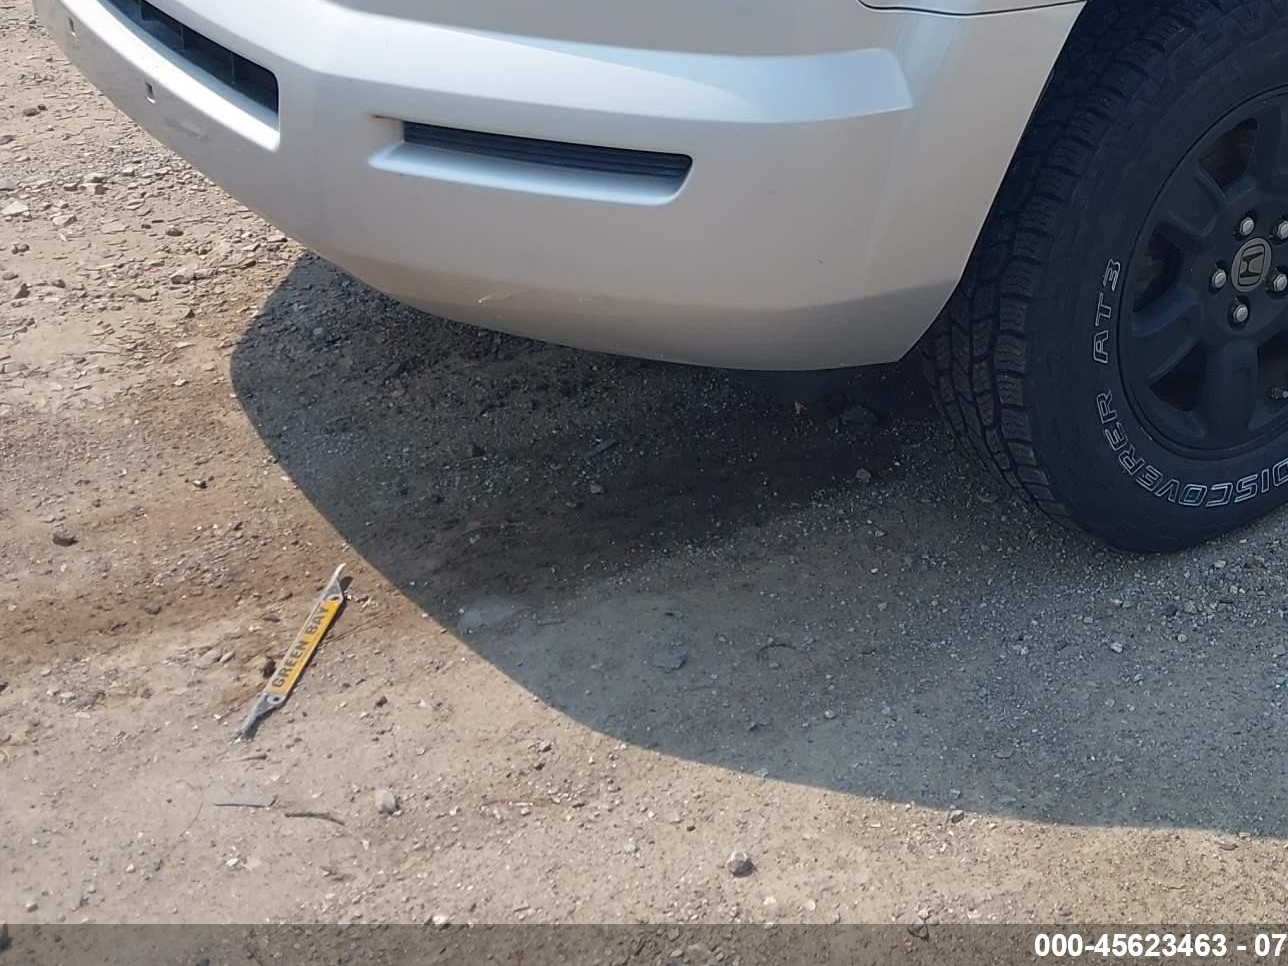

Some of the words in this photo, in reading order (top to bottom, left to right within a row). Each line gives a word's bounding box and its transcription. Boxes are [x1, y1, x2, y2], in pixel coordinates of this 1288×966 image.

[1092, 257, 1122, 365] AT3
[271, 638, 310, 688] GREEN
[304, 606, 330, 636] BAY
